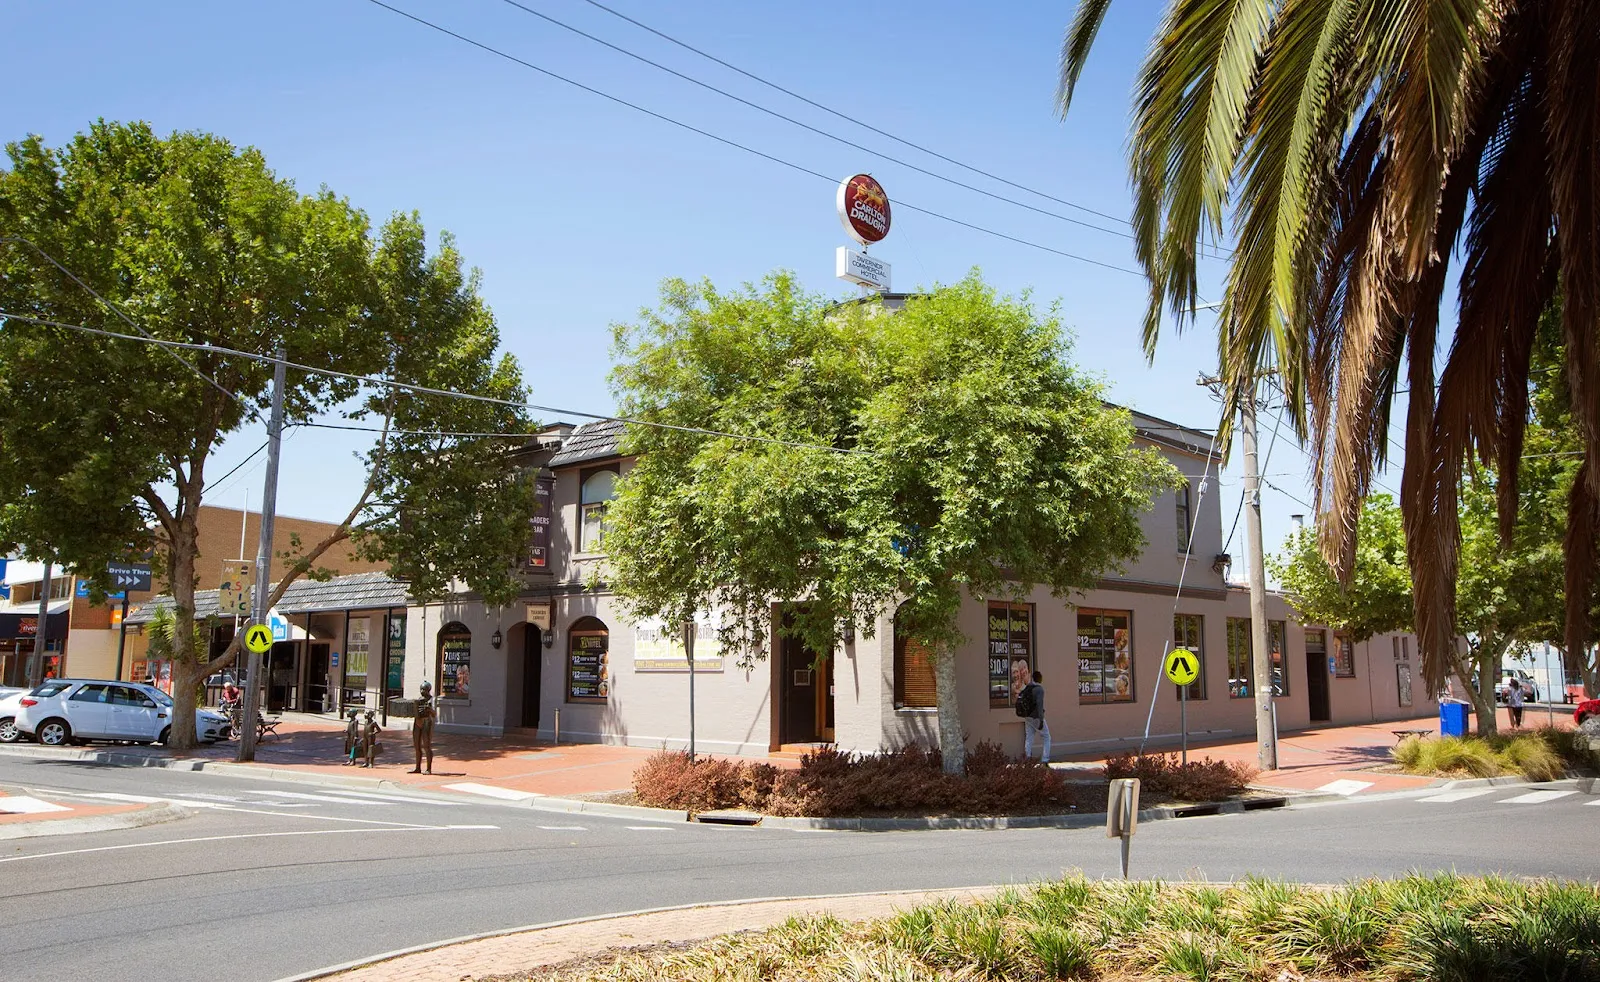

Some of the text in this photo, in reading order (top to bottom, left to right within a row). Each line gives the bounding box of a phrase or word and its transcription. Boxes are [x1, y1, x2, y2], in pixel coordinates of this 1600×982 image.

[854, 201, 886, 224] CARLTON
[850, 207, 886, 234] DRAUGHT
[852, 260, 886, 277] COMMERCIAL
[856, 256, 883, 270] TAVERNER
[861, 269, 879, 281] HOTEL
[529, 516, 549, 525] RADERS
[989, 615, 1029, 633] Seniors
[1077, 635, 1089, 647] $12
[990, 641, 1008, 654] 7 DAYS
[445, 651, 449, 660] 7
[1077, 658, 1089, 670] $12
[1078, 681, 1090, 693] $16
